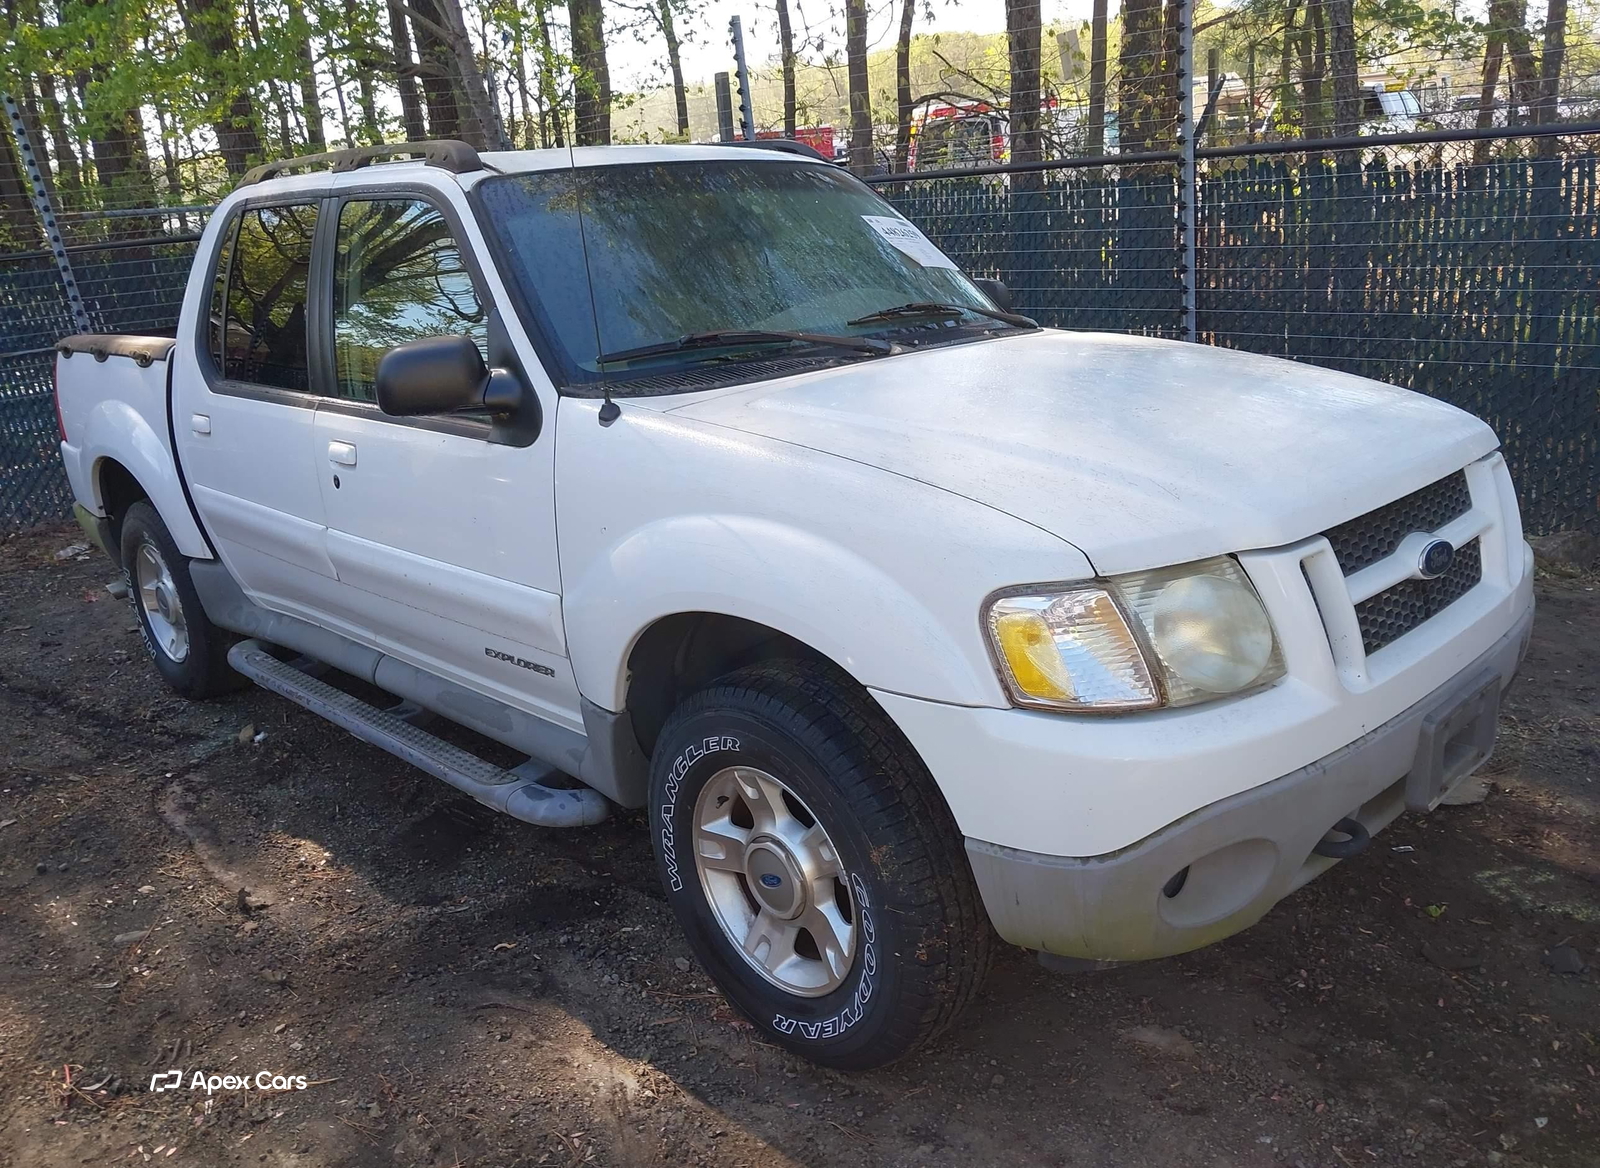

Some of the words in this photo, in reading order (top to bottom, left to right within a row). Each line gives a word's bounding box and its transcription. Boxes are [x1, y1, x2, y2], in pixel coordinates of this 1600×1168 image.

[484, 647, 556, 678] EXPLORER
[661, 736, 741, 892] WRANGLER
[772, 872, 877, 1039] GOODYEAR
